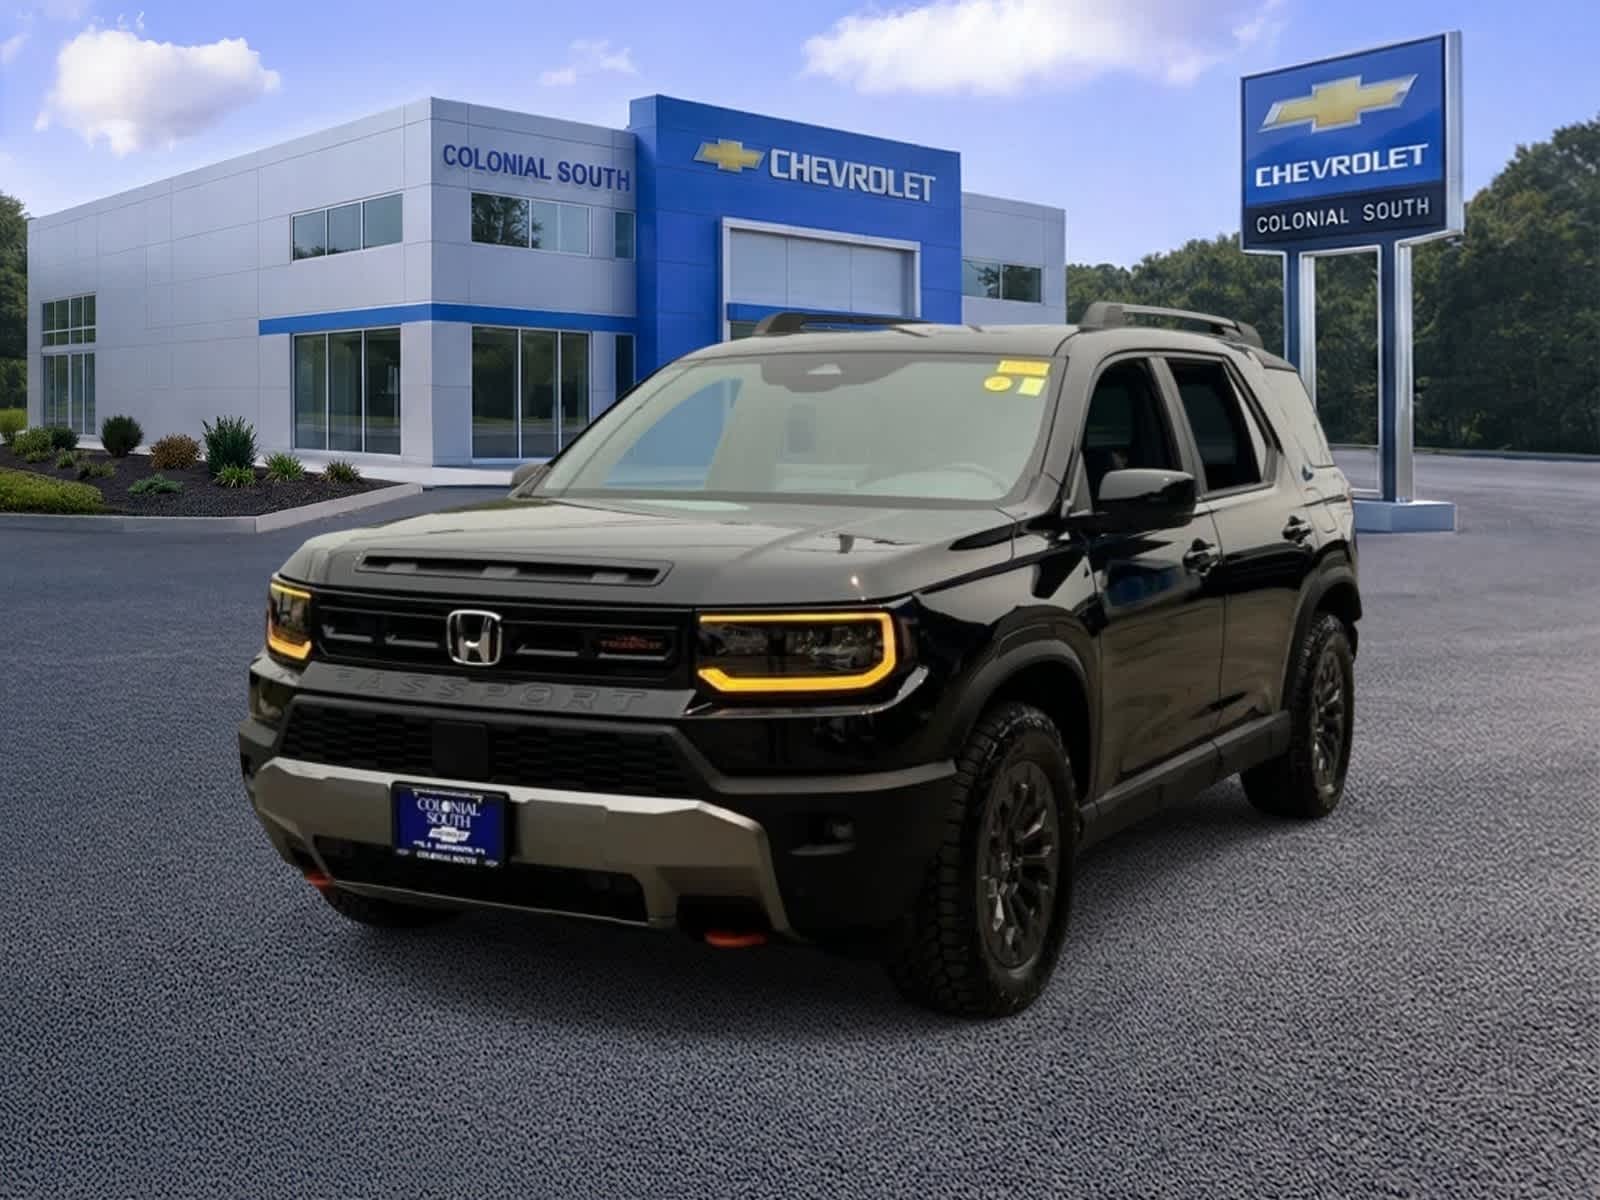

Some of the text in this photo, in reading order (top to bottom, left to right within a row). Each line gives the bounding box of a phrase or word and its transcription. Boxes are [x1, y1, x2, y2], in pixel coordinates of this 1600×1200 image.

[443, 144, 631, 192] COLONIAL SOUTH
[770, 148, 936, 203] CHEVROLET
[1255, 143, 1428, 187] CHEVROLET
[1256, 197, 1430, 234] COLONIAL SOUTH
[417, 797, 481, 817] COLONIAL
[426, 811, 472, 829] SOUTH
